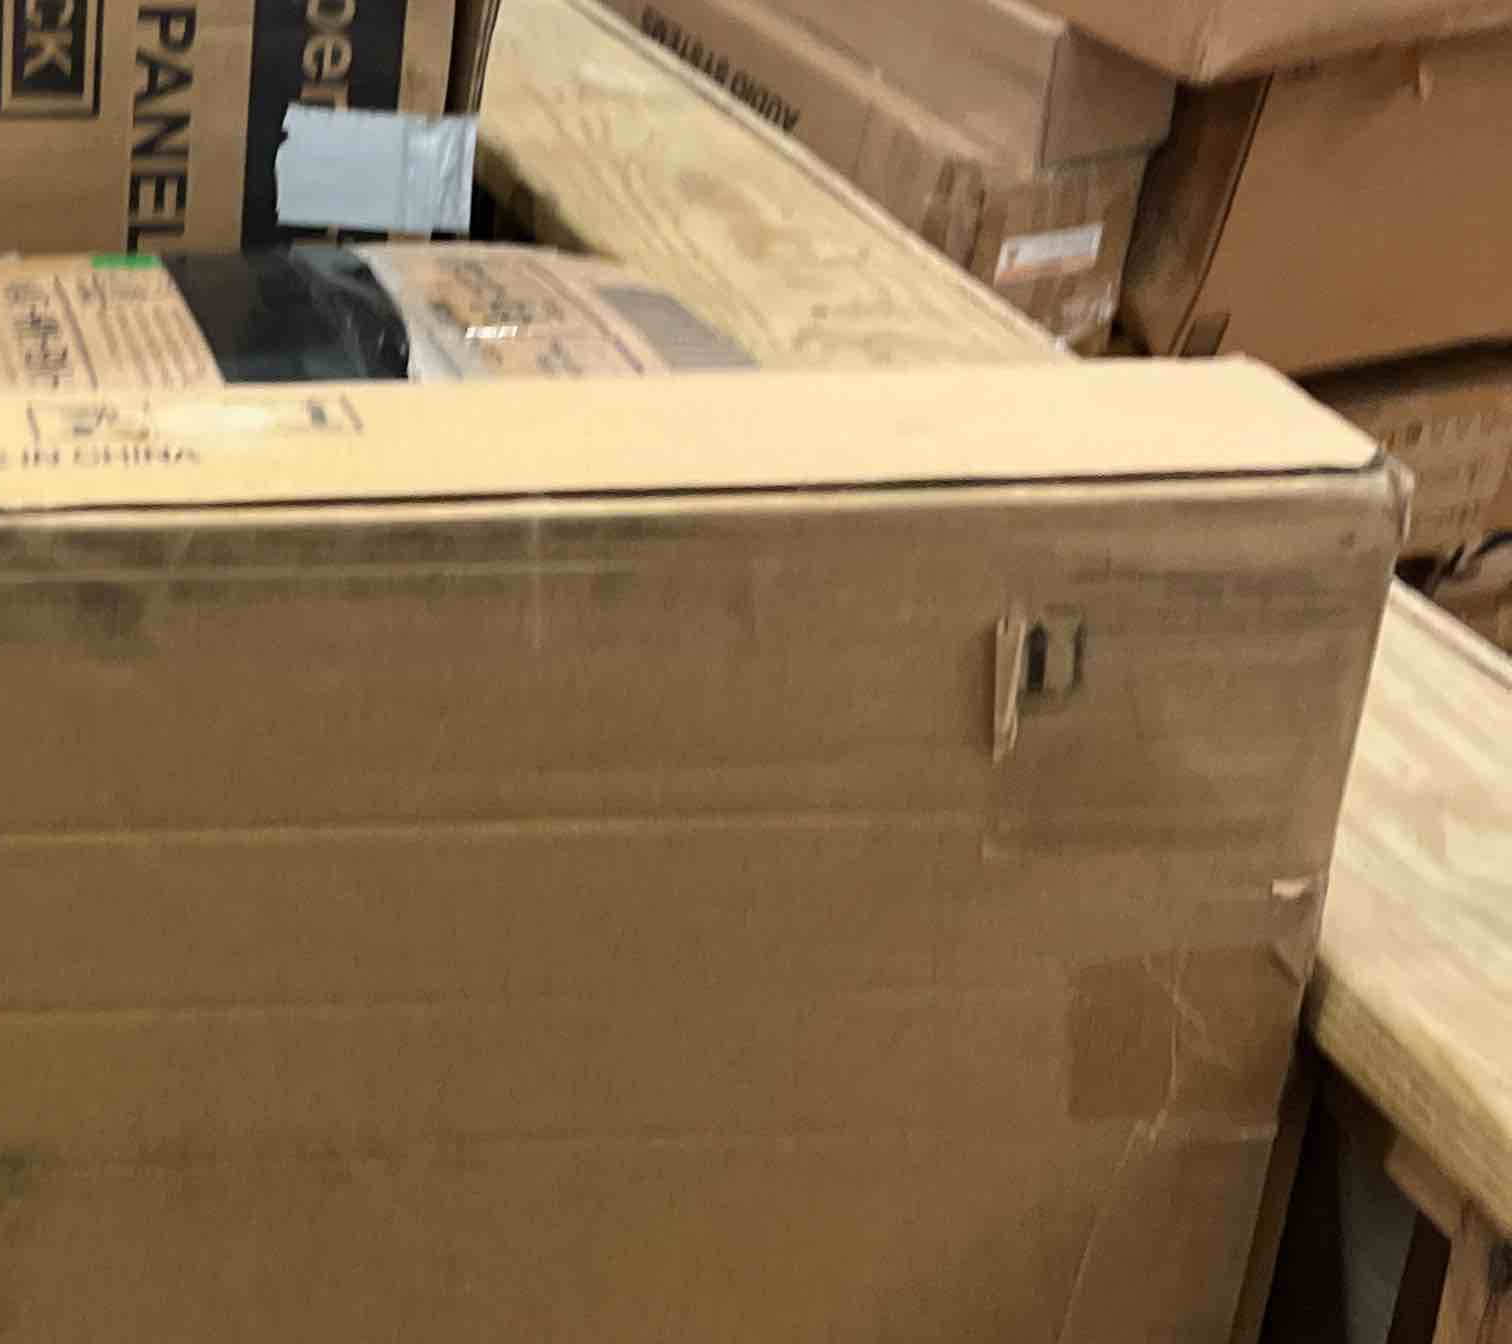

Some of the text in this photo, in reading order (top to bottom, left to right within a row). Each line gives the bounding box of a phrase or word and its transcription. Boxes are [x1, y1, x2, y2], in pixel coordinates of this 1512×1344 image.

[127, 6, 198, 253] PANEL
[21, 445, 60, 465] IN
[74, 442, 200, 465] CHINA
